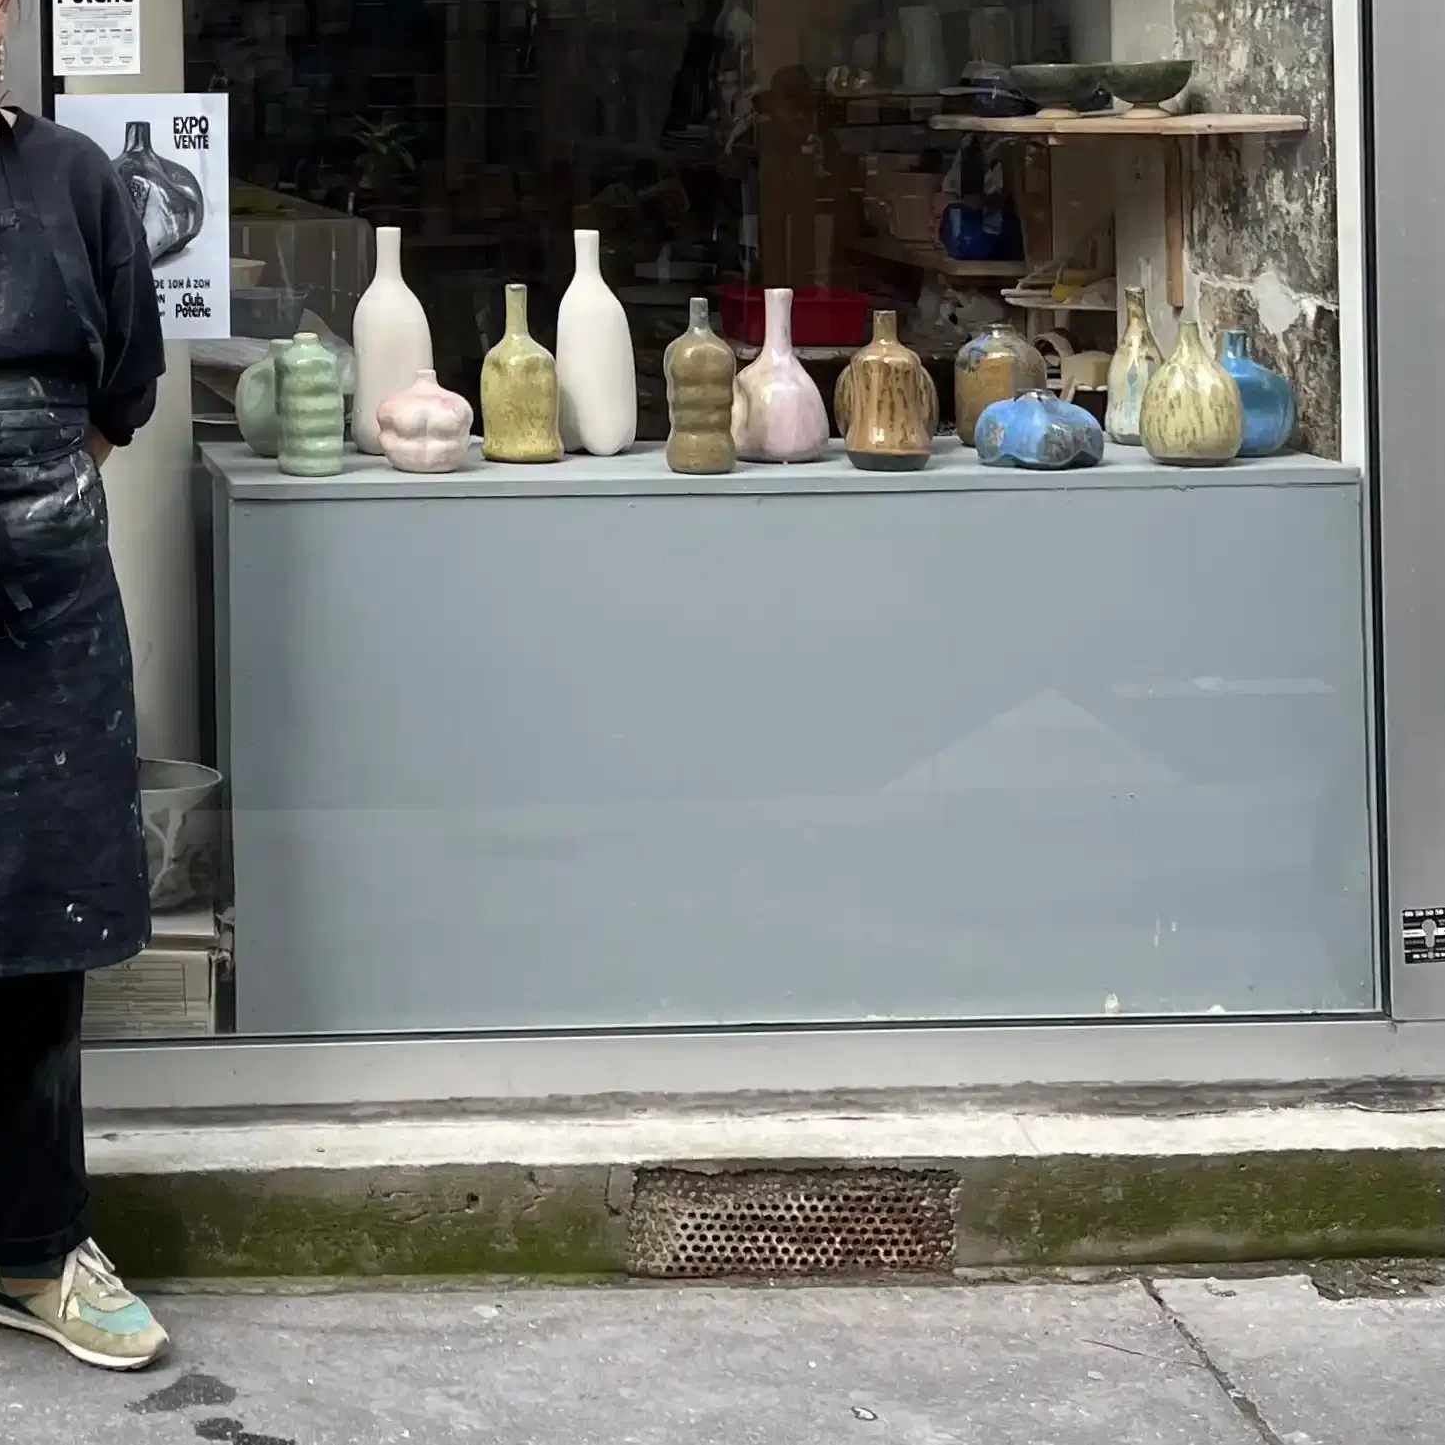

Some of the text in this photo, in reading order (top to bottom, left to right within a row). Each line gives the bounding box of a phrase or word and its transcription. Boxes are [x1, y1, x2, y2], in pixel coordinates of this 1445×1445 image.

[173, 116, 209, 134] EXPO
[174, 135, 209, 149] VENTE
[193, 279, 210, 289] 20H
[175, 303, 211, 318] Poterie
